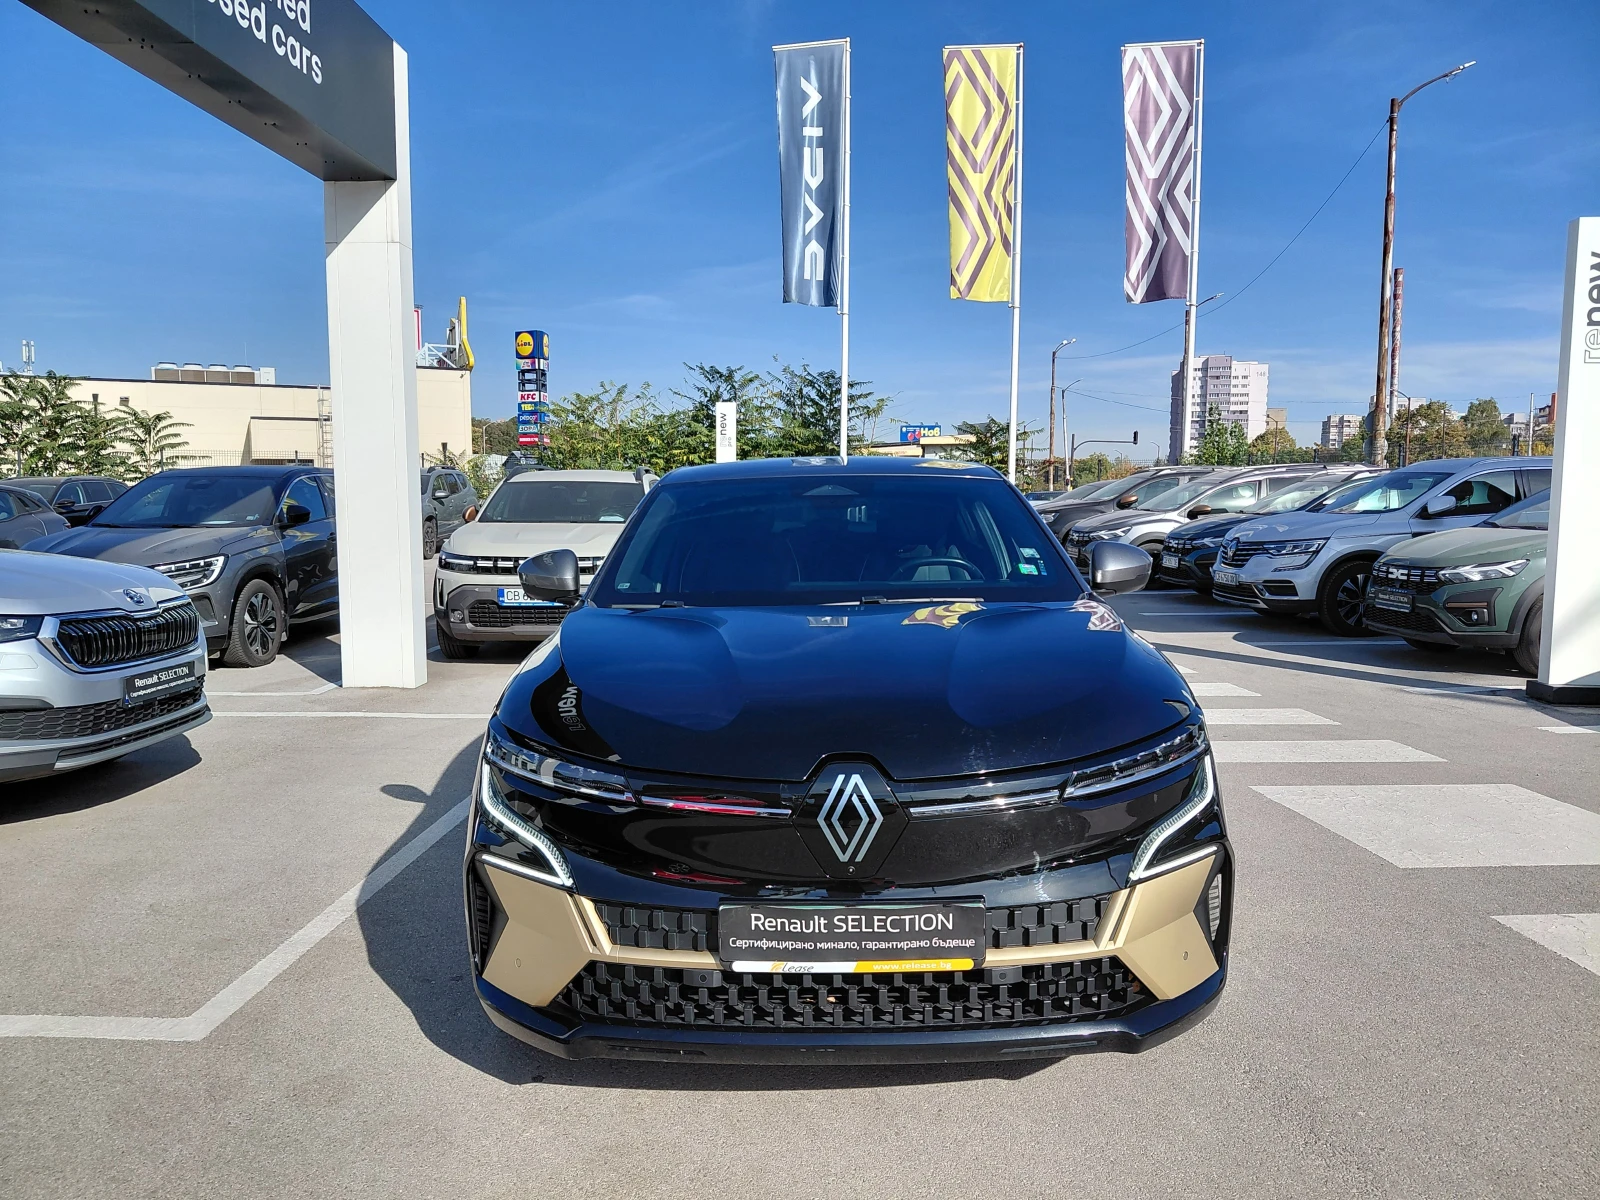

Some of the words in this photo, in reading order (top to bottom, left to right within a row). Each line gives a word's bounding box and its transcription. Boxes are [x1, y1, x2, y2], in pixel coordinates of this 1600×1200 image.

[207, 0, 266, 43] ed
[272, 24, 322, 84] cars
[520, 393, 536, 401] KFC
[134, 674, 159, 687] Renault
[159, 666, 189, 681] SELECTION
[750, 913, 828, 933] Renault
[833, 913, 953, 932] SELECTION
[729, 937, 815, 951] Сертифицирано
[817, 941, 860, 950] минало,
[862, 939, 930, 951] гарантирано
[932, 937, 976, 948] бъдеще
[872, 961, 953, 971] www.release.bg
